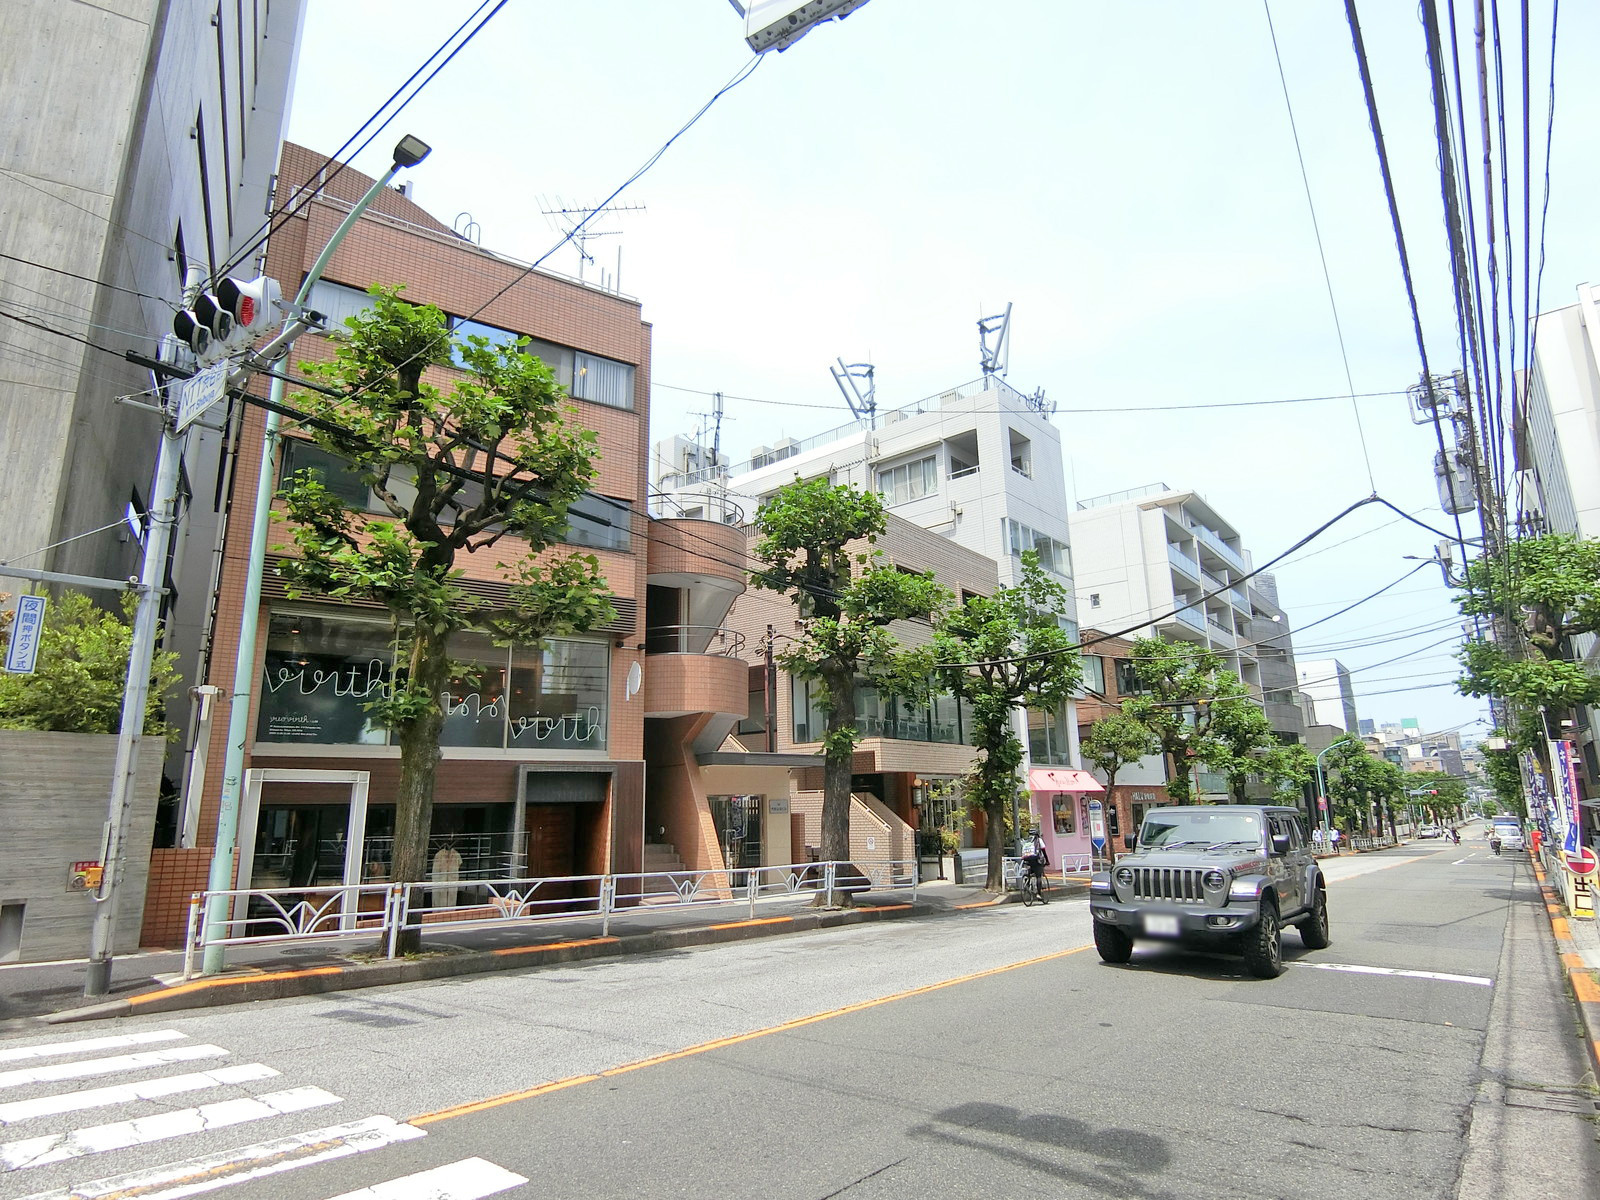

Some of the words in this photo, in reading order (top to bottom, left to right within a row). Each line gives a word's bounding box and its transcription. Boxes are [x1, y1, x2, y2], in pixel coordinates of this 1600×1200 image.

[196, 389, 216, 410] Shibuya
[16, 600, 39, 669] 夜間押ボタン式
[1574, 877, 1594, 910] 出口
